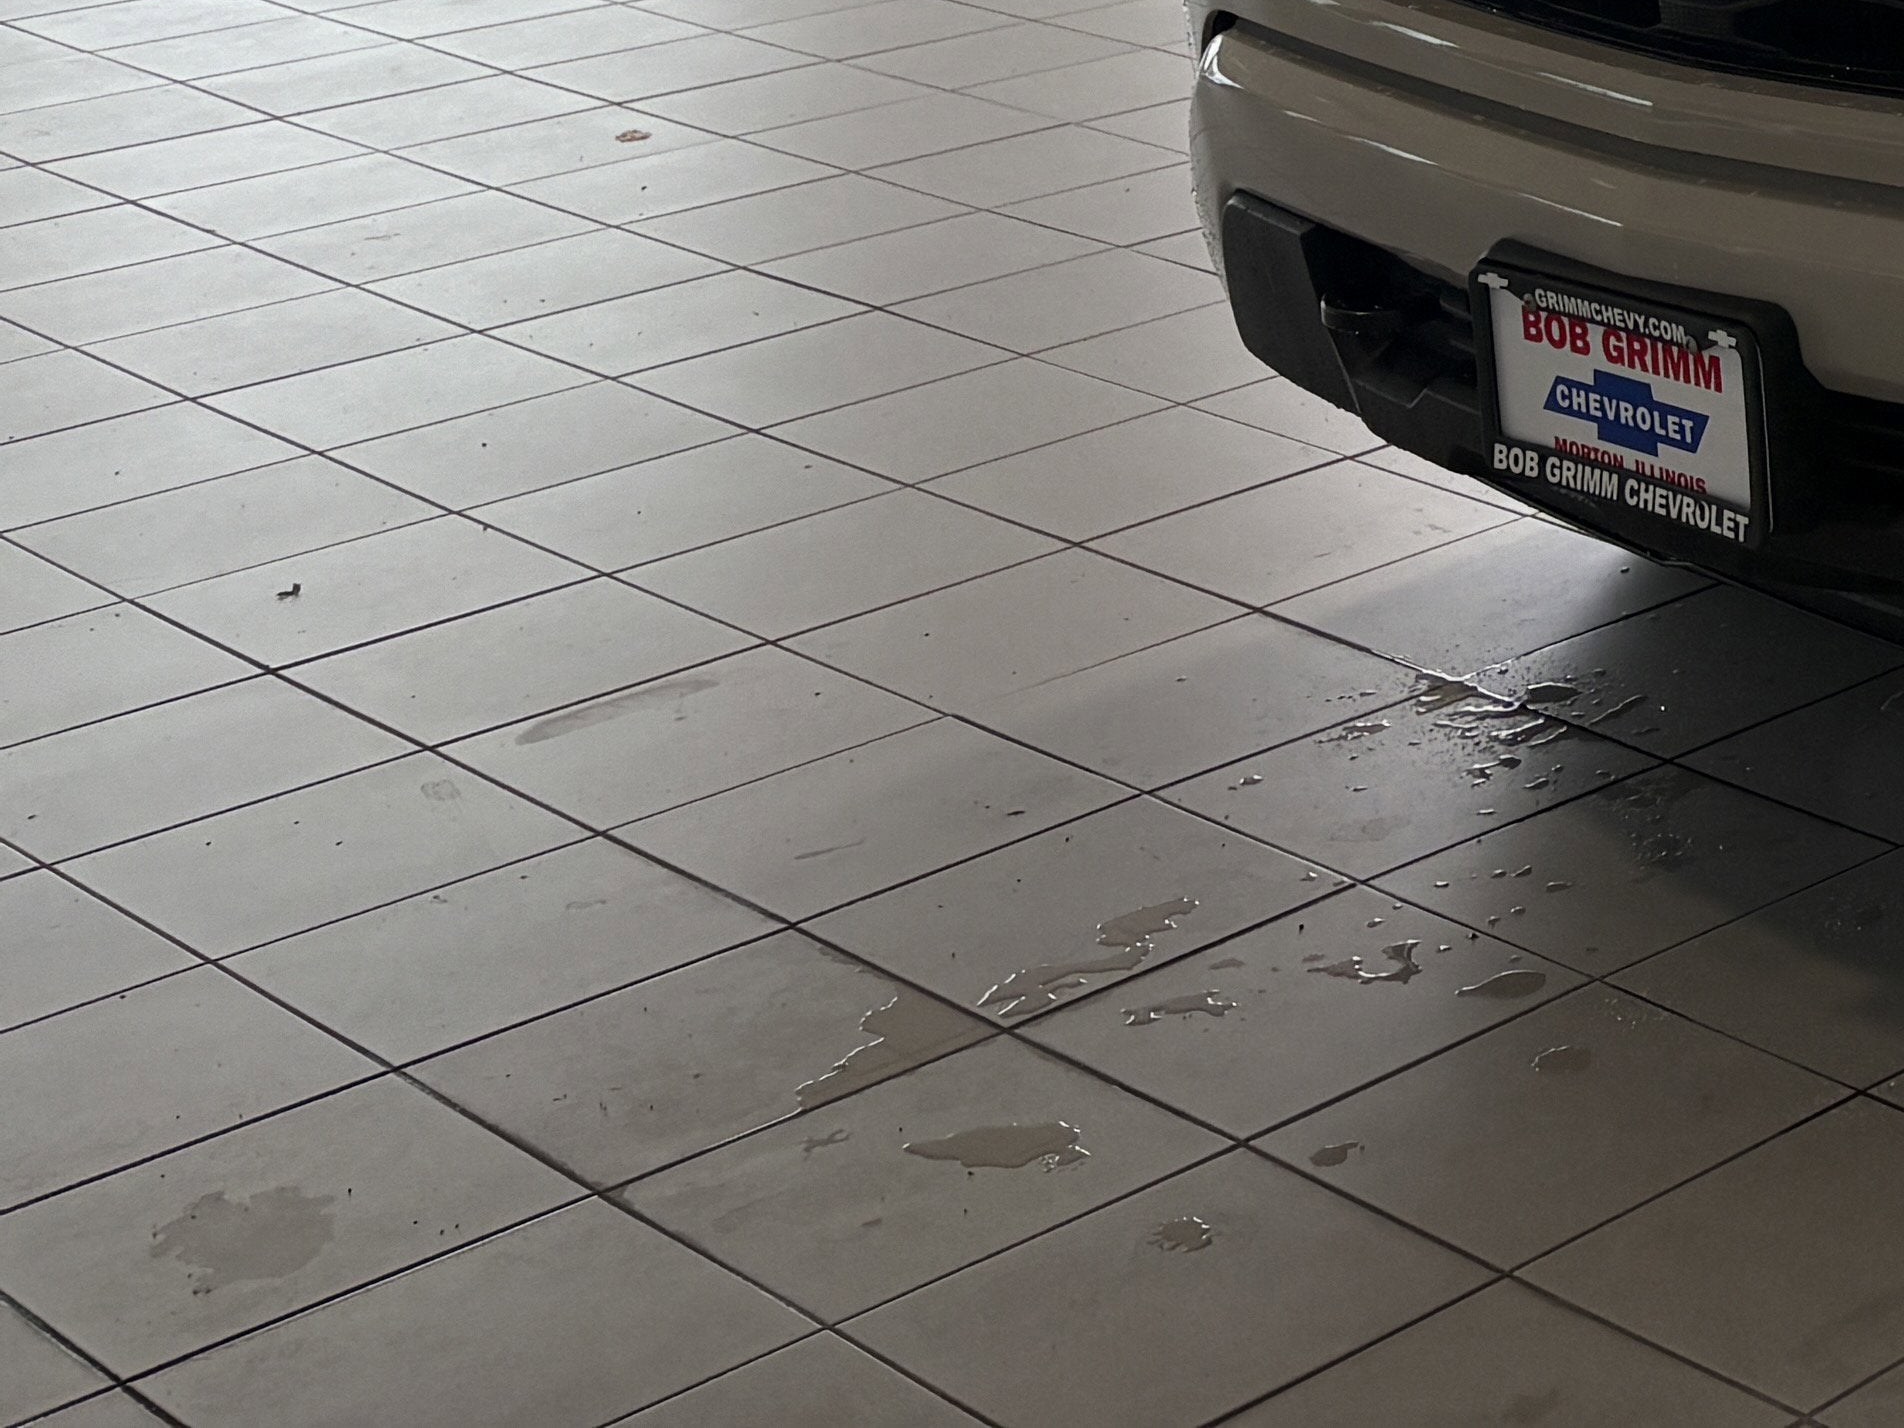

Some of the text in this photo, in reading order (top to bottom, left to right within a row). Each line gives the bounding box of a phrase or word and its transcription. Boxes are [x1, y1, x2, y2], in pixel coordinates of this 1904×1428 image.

[1534, 288, 1688, 344] GRIMMCHEVY.COM
[1521, 304, 1723, 394] BOB GRIMM
[1555, 384, 1694, 444] CHEVROLET
[1493, 443, 1750, 543] BOB GRIMM CHEVROLET
[1553, 435, 1707, 493] MORTON ILLINOIS
